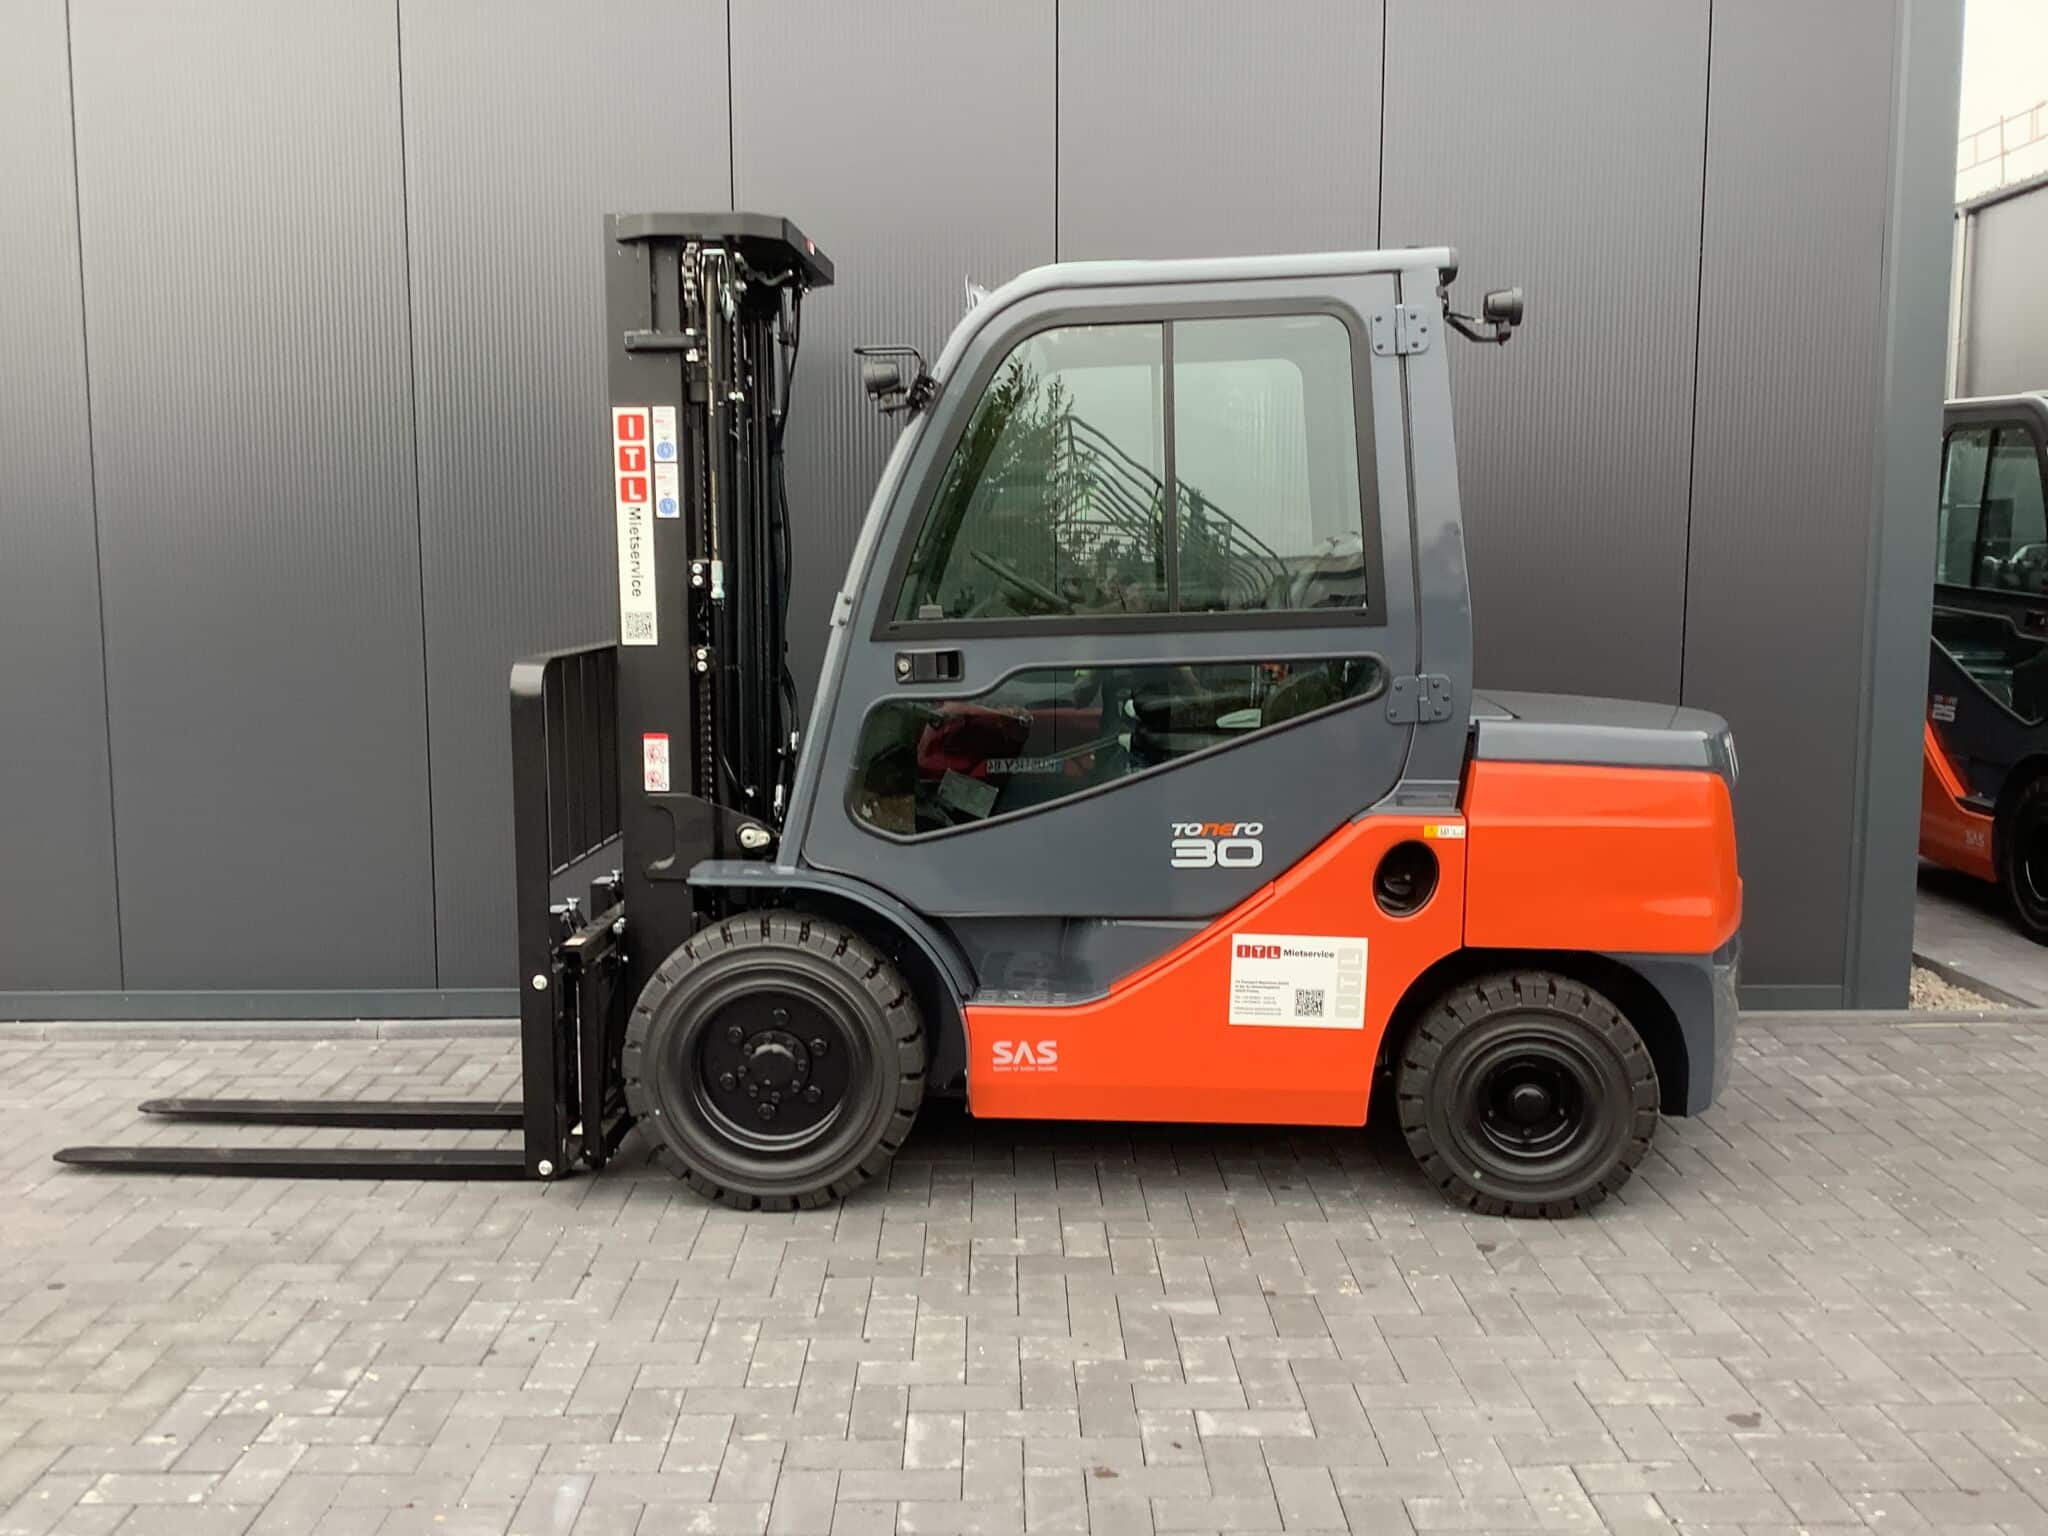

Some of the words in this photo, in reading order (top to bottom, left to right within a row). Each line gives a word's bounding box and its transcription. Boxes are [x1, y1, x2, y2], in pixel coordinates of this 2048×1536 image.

[620, 416, 644, 501] ITL
[627, 506, 642, 598] Mietservice
[1932, 704, 1956, 722] 25
[1170, 839, 1264, 868] 30
[1238, 945, 1280, 958] ITL
[1283, 949, 1335, 959] Mietservice
[992, 1040, 1058, 1065] SAS
